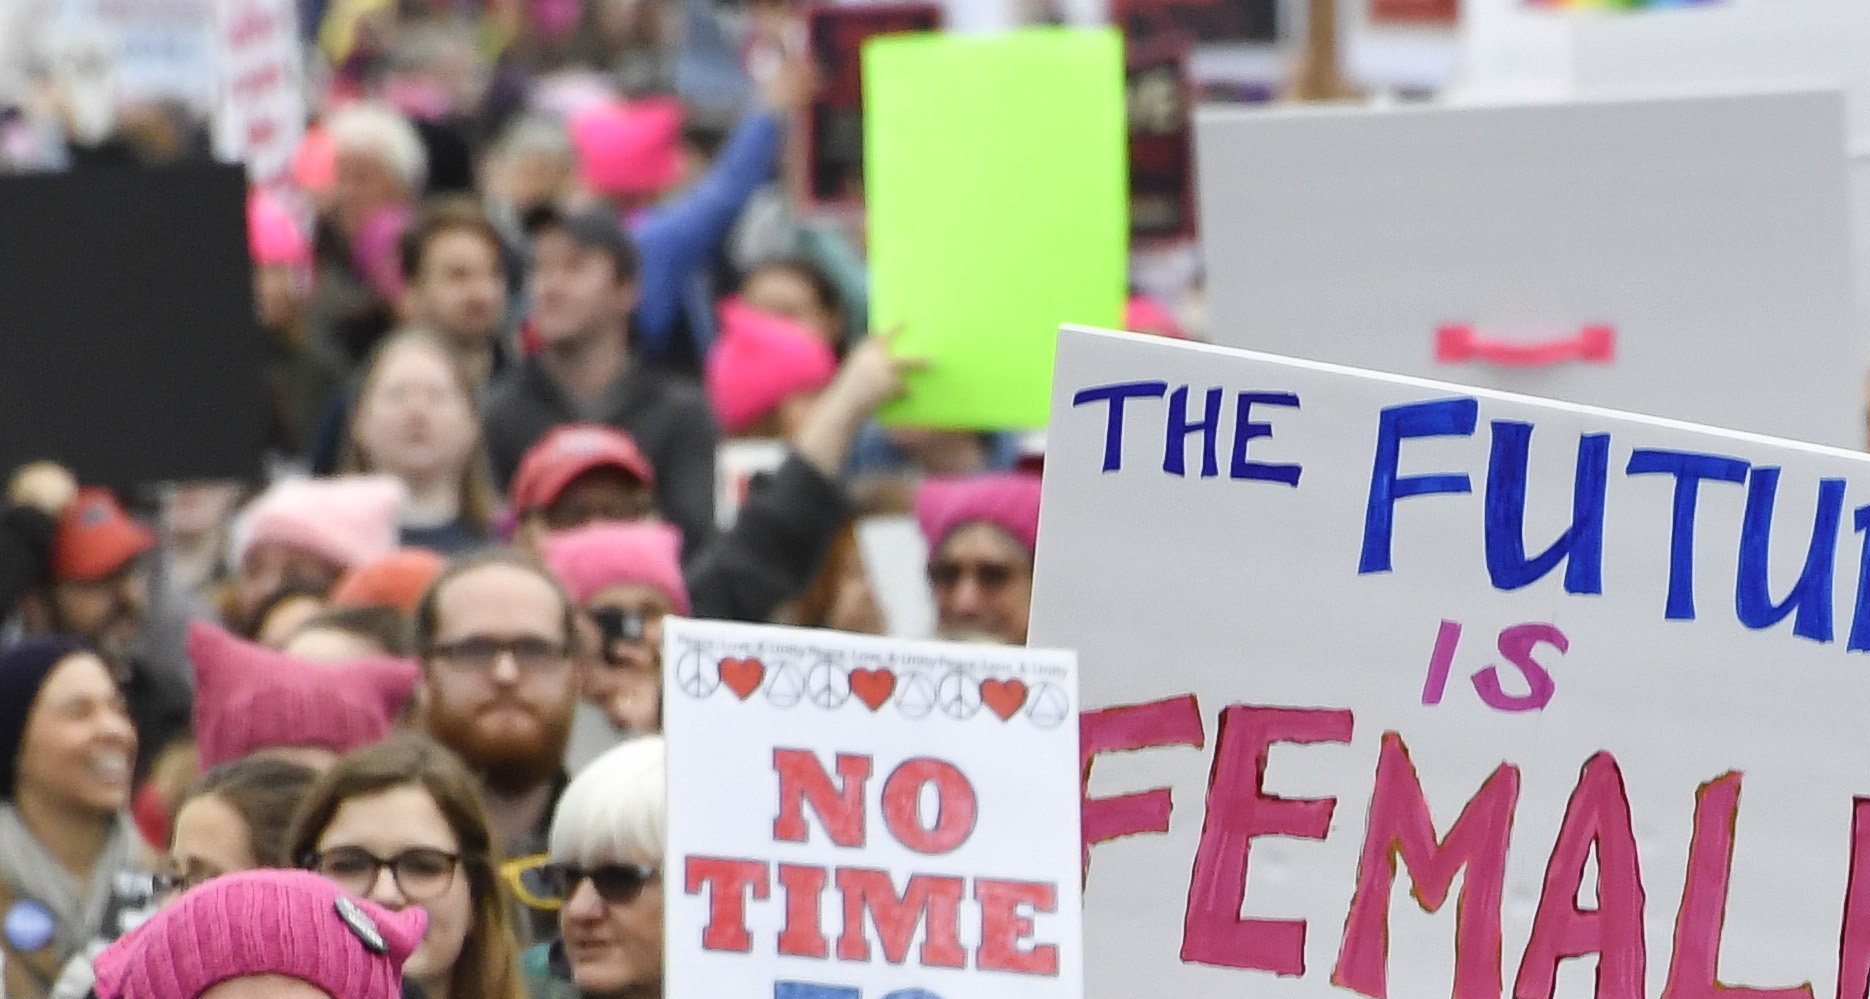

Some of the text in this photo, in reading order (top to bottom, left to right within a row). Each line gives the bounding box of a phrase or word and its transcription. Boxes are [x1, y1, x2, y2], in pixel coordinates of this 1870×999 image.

[1073, 382, 1303, 487] THE
[1421, 620, 1570, 714] IS
[772, 747, 979, 855] NO
[685, 855, 1060, 977] TIME
